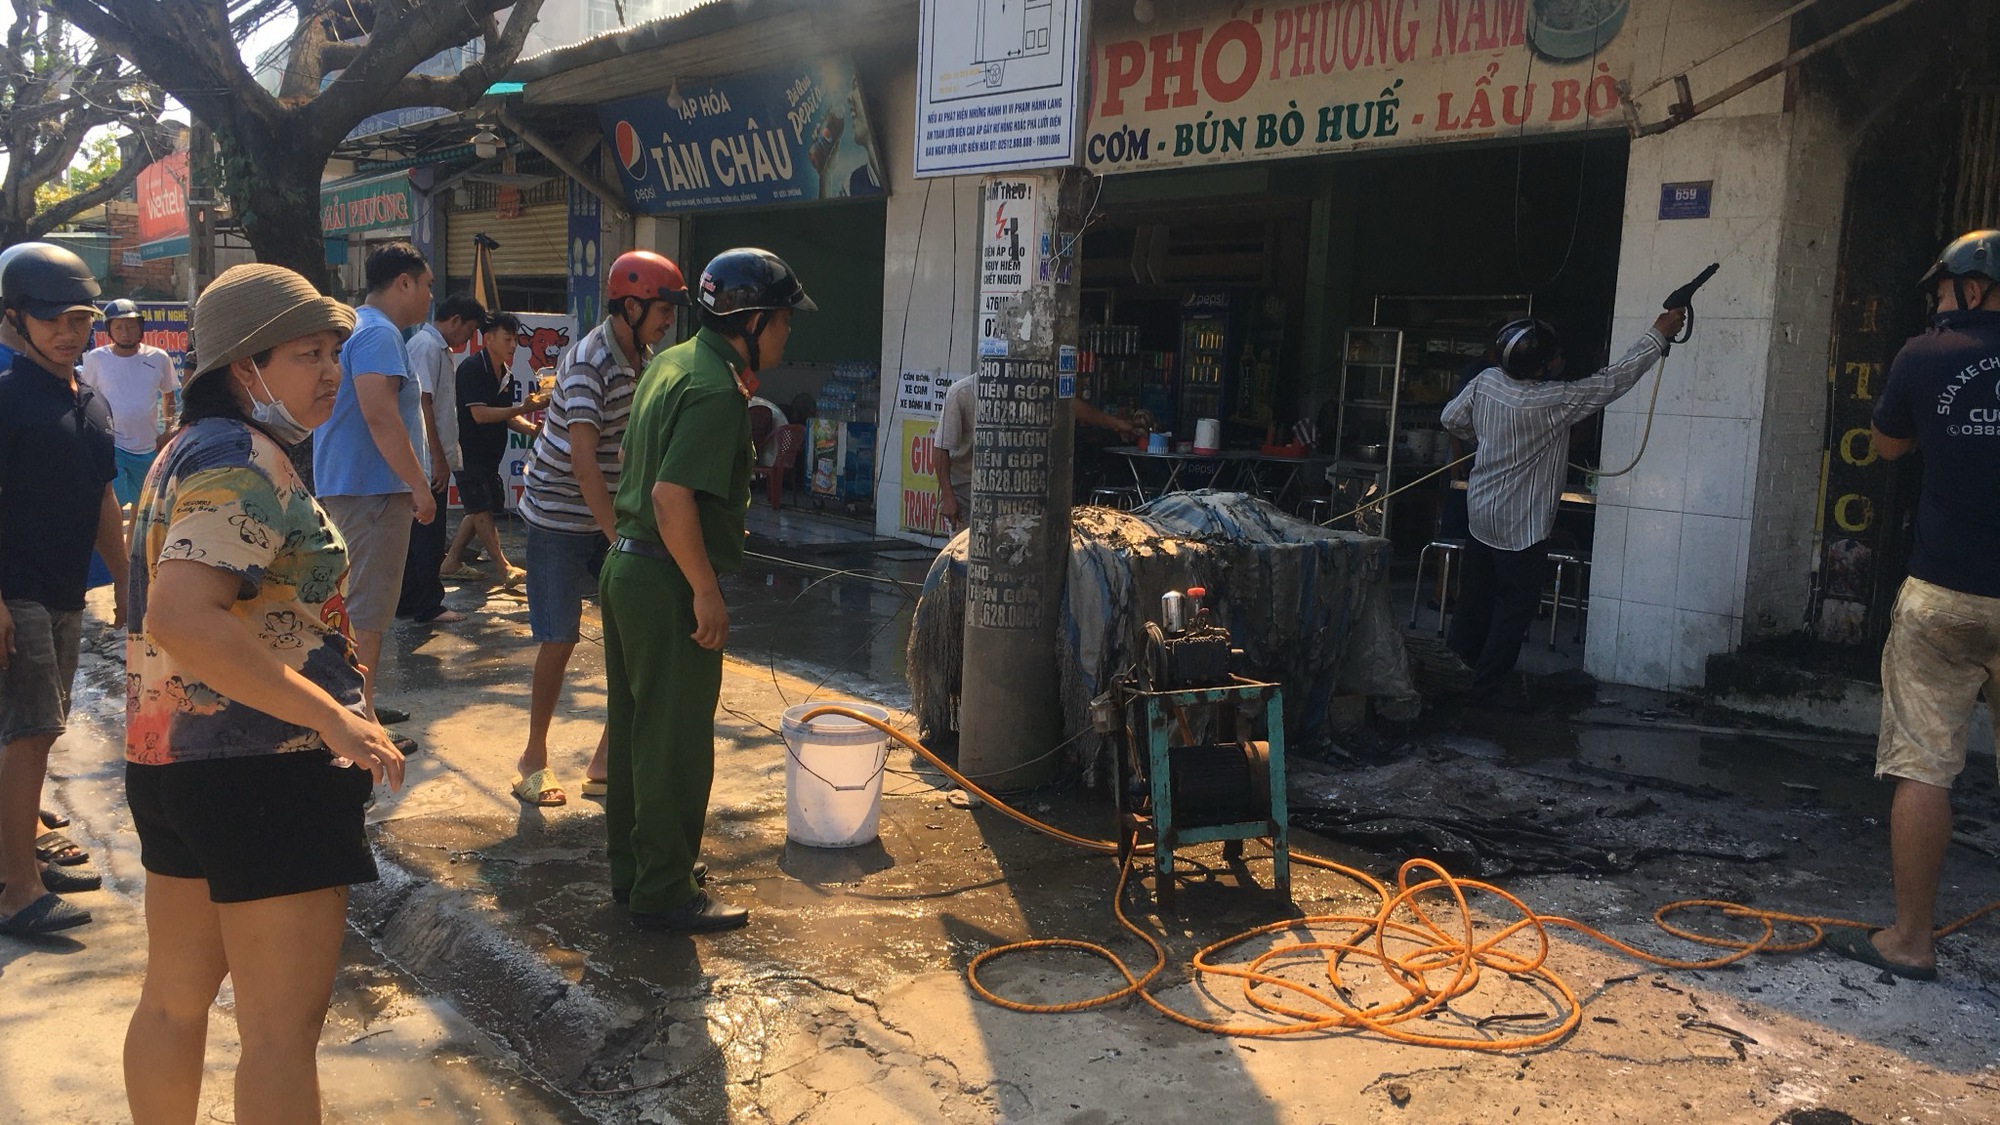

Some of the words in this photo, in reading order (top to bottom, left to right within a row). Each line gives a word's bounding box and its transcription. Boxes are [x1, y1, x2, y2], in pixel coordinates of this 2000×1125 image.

[1101, 2, 1263, 117] PHỞ
[1431, 0, 1525, 58] NAM
[677, 98, 697, 125] TẠP
[700, 87, 731, 117] HÓA
[1047, 97, 1062, 109] LANG
[1088, 124, 1150, 164] CƠM
[1173, 111, 1247, 157] BÚN
[1255, 100, 1305, 149] BÒ
[1315, 79, 1404, 143] HUẾ
[1434, 62, 1537, 132] LẨU
[1548, 62, 1620, 122] BÒ
[650, 132, 711, 192] TÂM
[710, 117, 793, 187] CHÂU
[634, 184, 656, 203] pepsi
[1675, 189, 1697, 200] 659
[348, 191, 409, 227] PHƯƠNG
[996, 245, 1006, 257] ÁP
[1008, 246, 1025, 258] CO
[997, 272, 1022, 285] NGƯỜI
[1196, 292, 1224, 306] pepsi
[168, 309, 187, 324] NGHỆ
[980, 361, 1000, 377] CHO
[905, 384, 912, 394] XE
[914, 385, 928, 395] CAM
[1014, 382, 1050, 400] GÓP
[1937, 385, 1961, 415] SỬA
[1956, 365, 1979, 384] XE
[900, 399, 907, 408] XE
[975, 431, 993, 447] CHO
